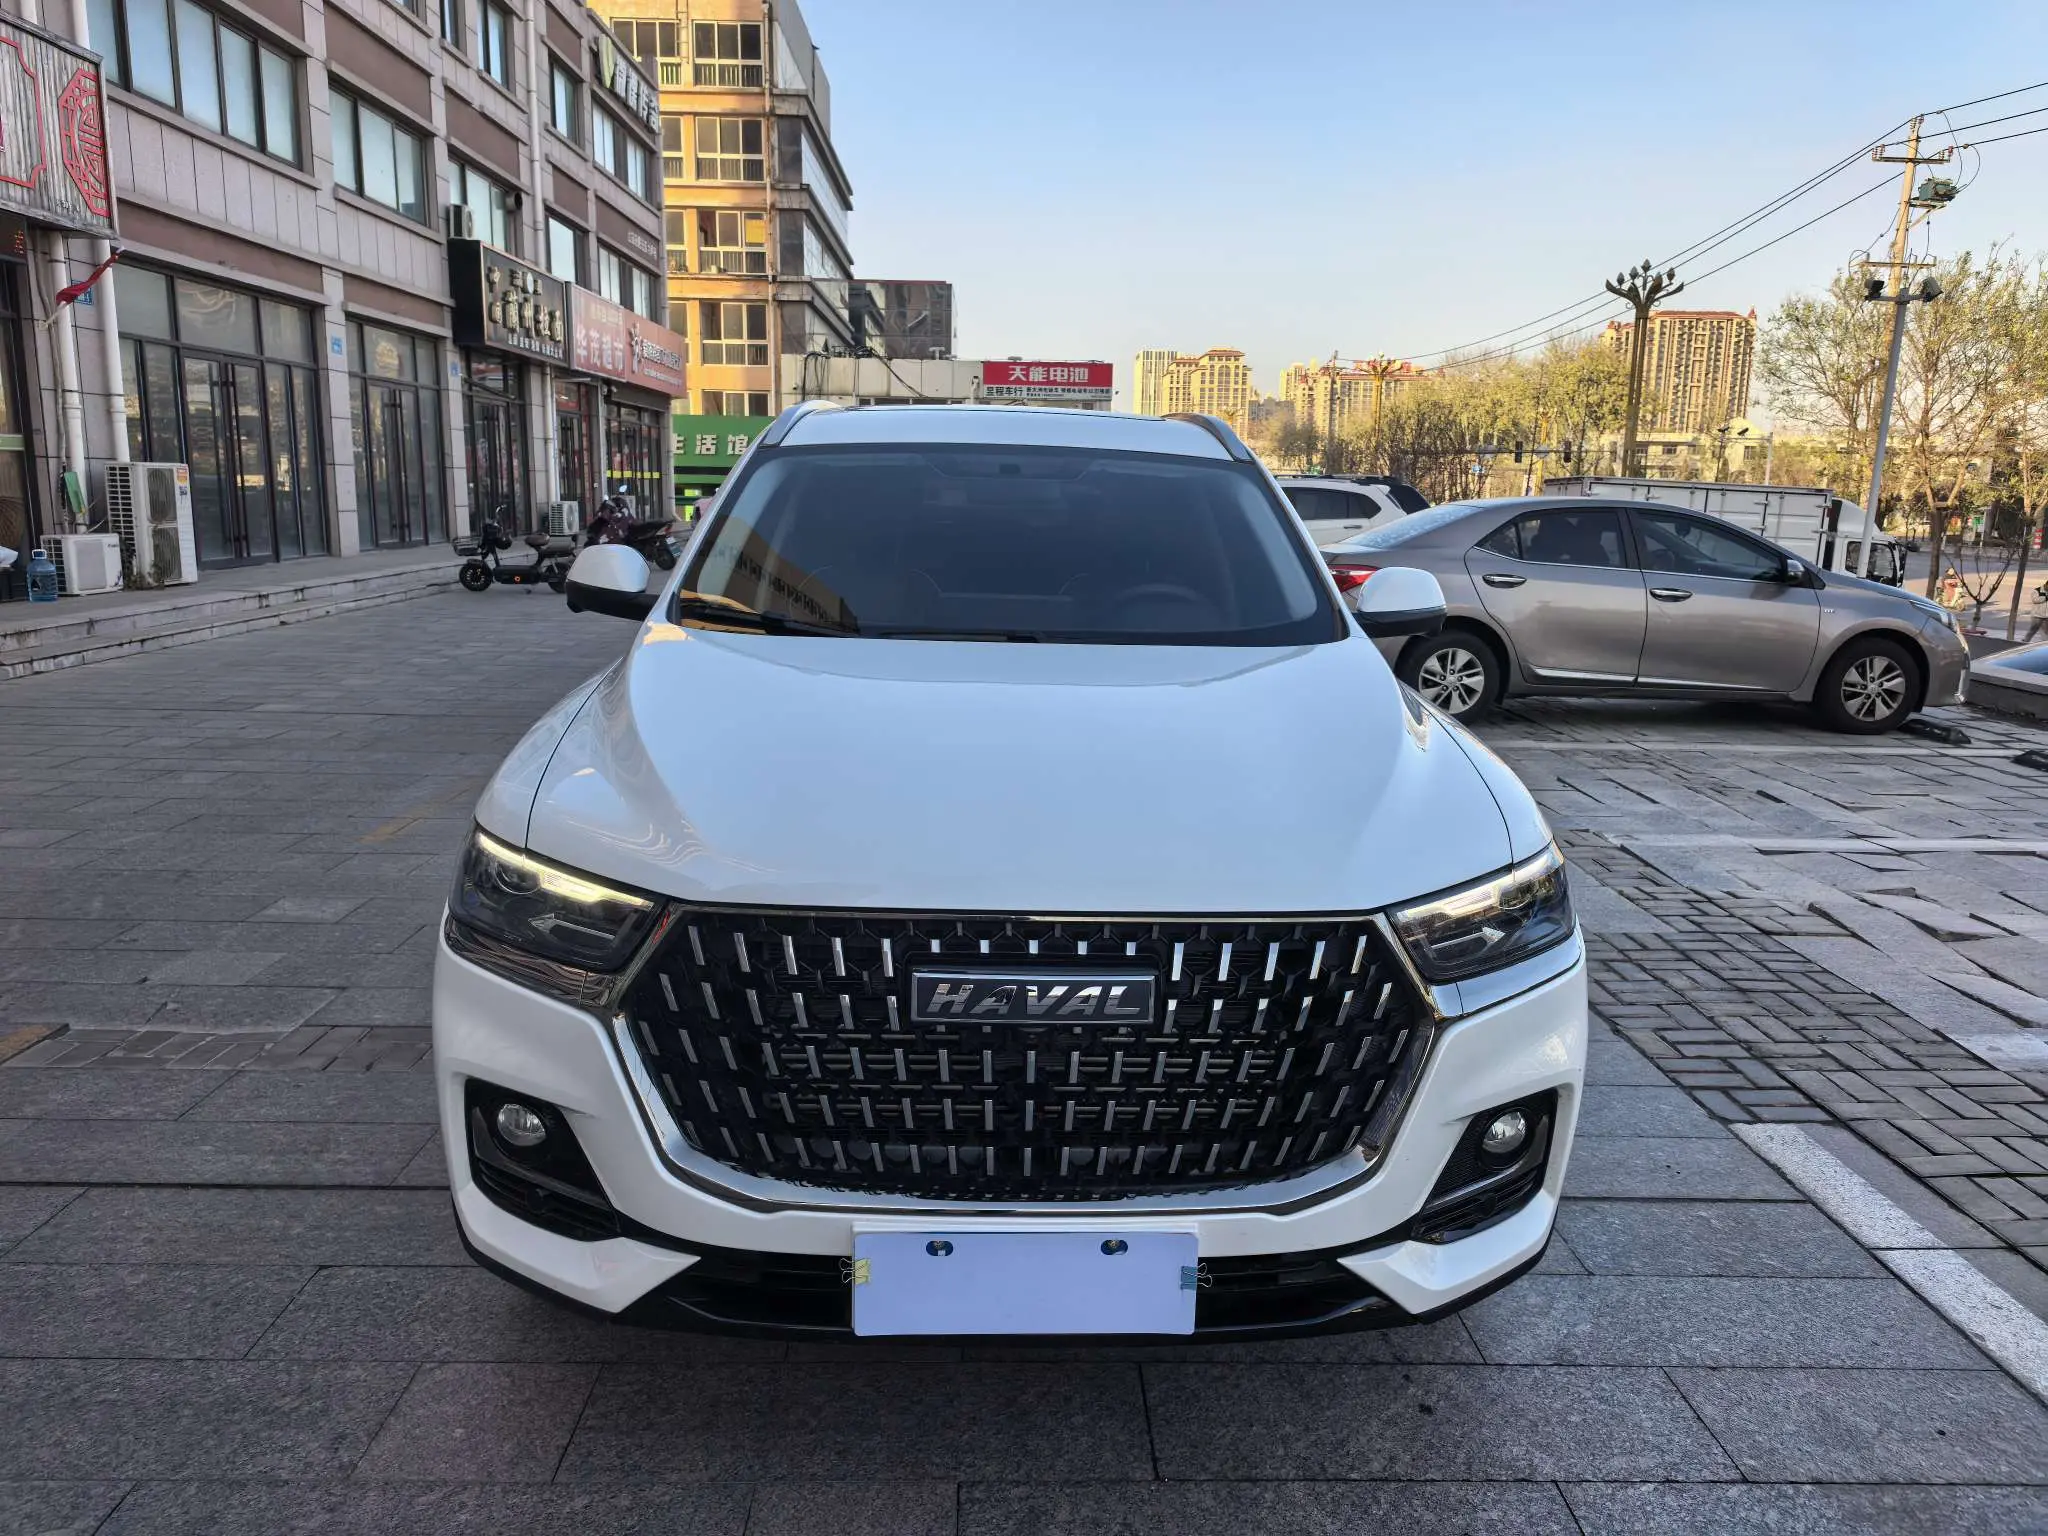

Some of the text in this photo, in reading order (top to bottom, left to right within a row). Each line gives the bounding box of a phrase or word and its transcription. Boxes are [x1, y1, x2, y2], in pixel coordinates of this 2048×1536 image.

[1008, 365, 1089, 383] 天能电池
[926, 983, 1141, 1016] HAVAL
